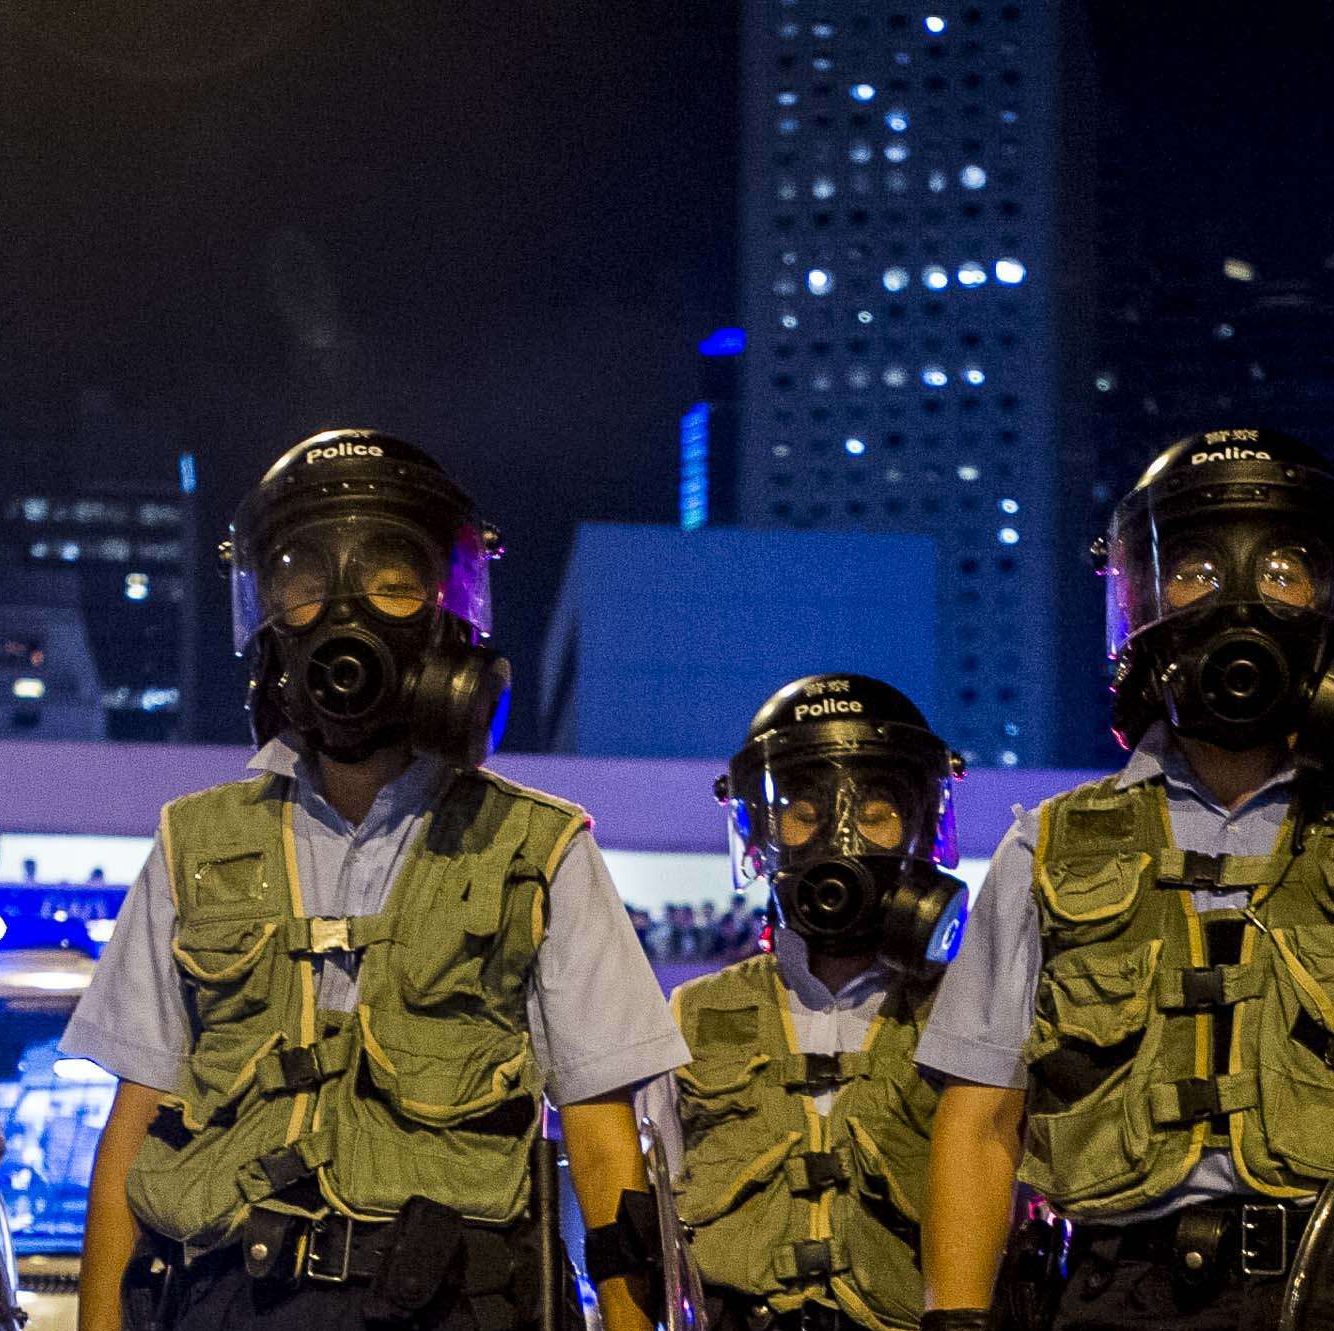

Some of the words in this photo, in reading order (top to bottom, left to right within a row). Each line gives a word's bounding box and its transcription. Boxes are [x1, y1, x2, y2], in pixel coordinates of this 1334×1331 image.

[307, 442, 384, 464] Police
[1191, 446, 1272, 465] Police
[795, 698, 864, 721] Police
